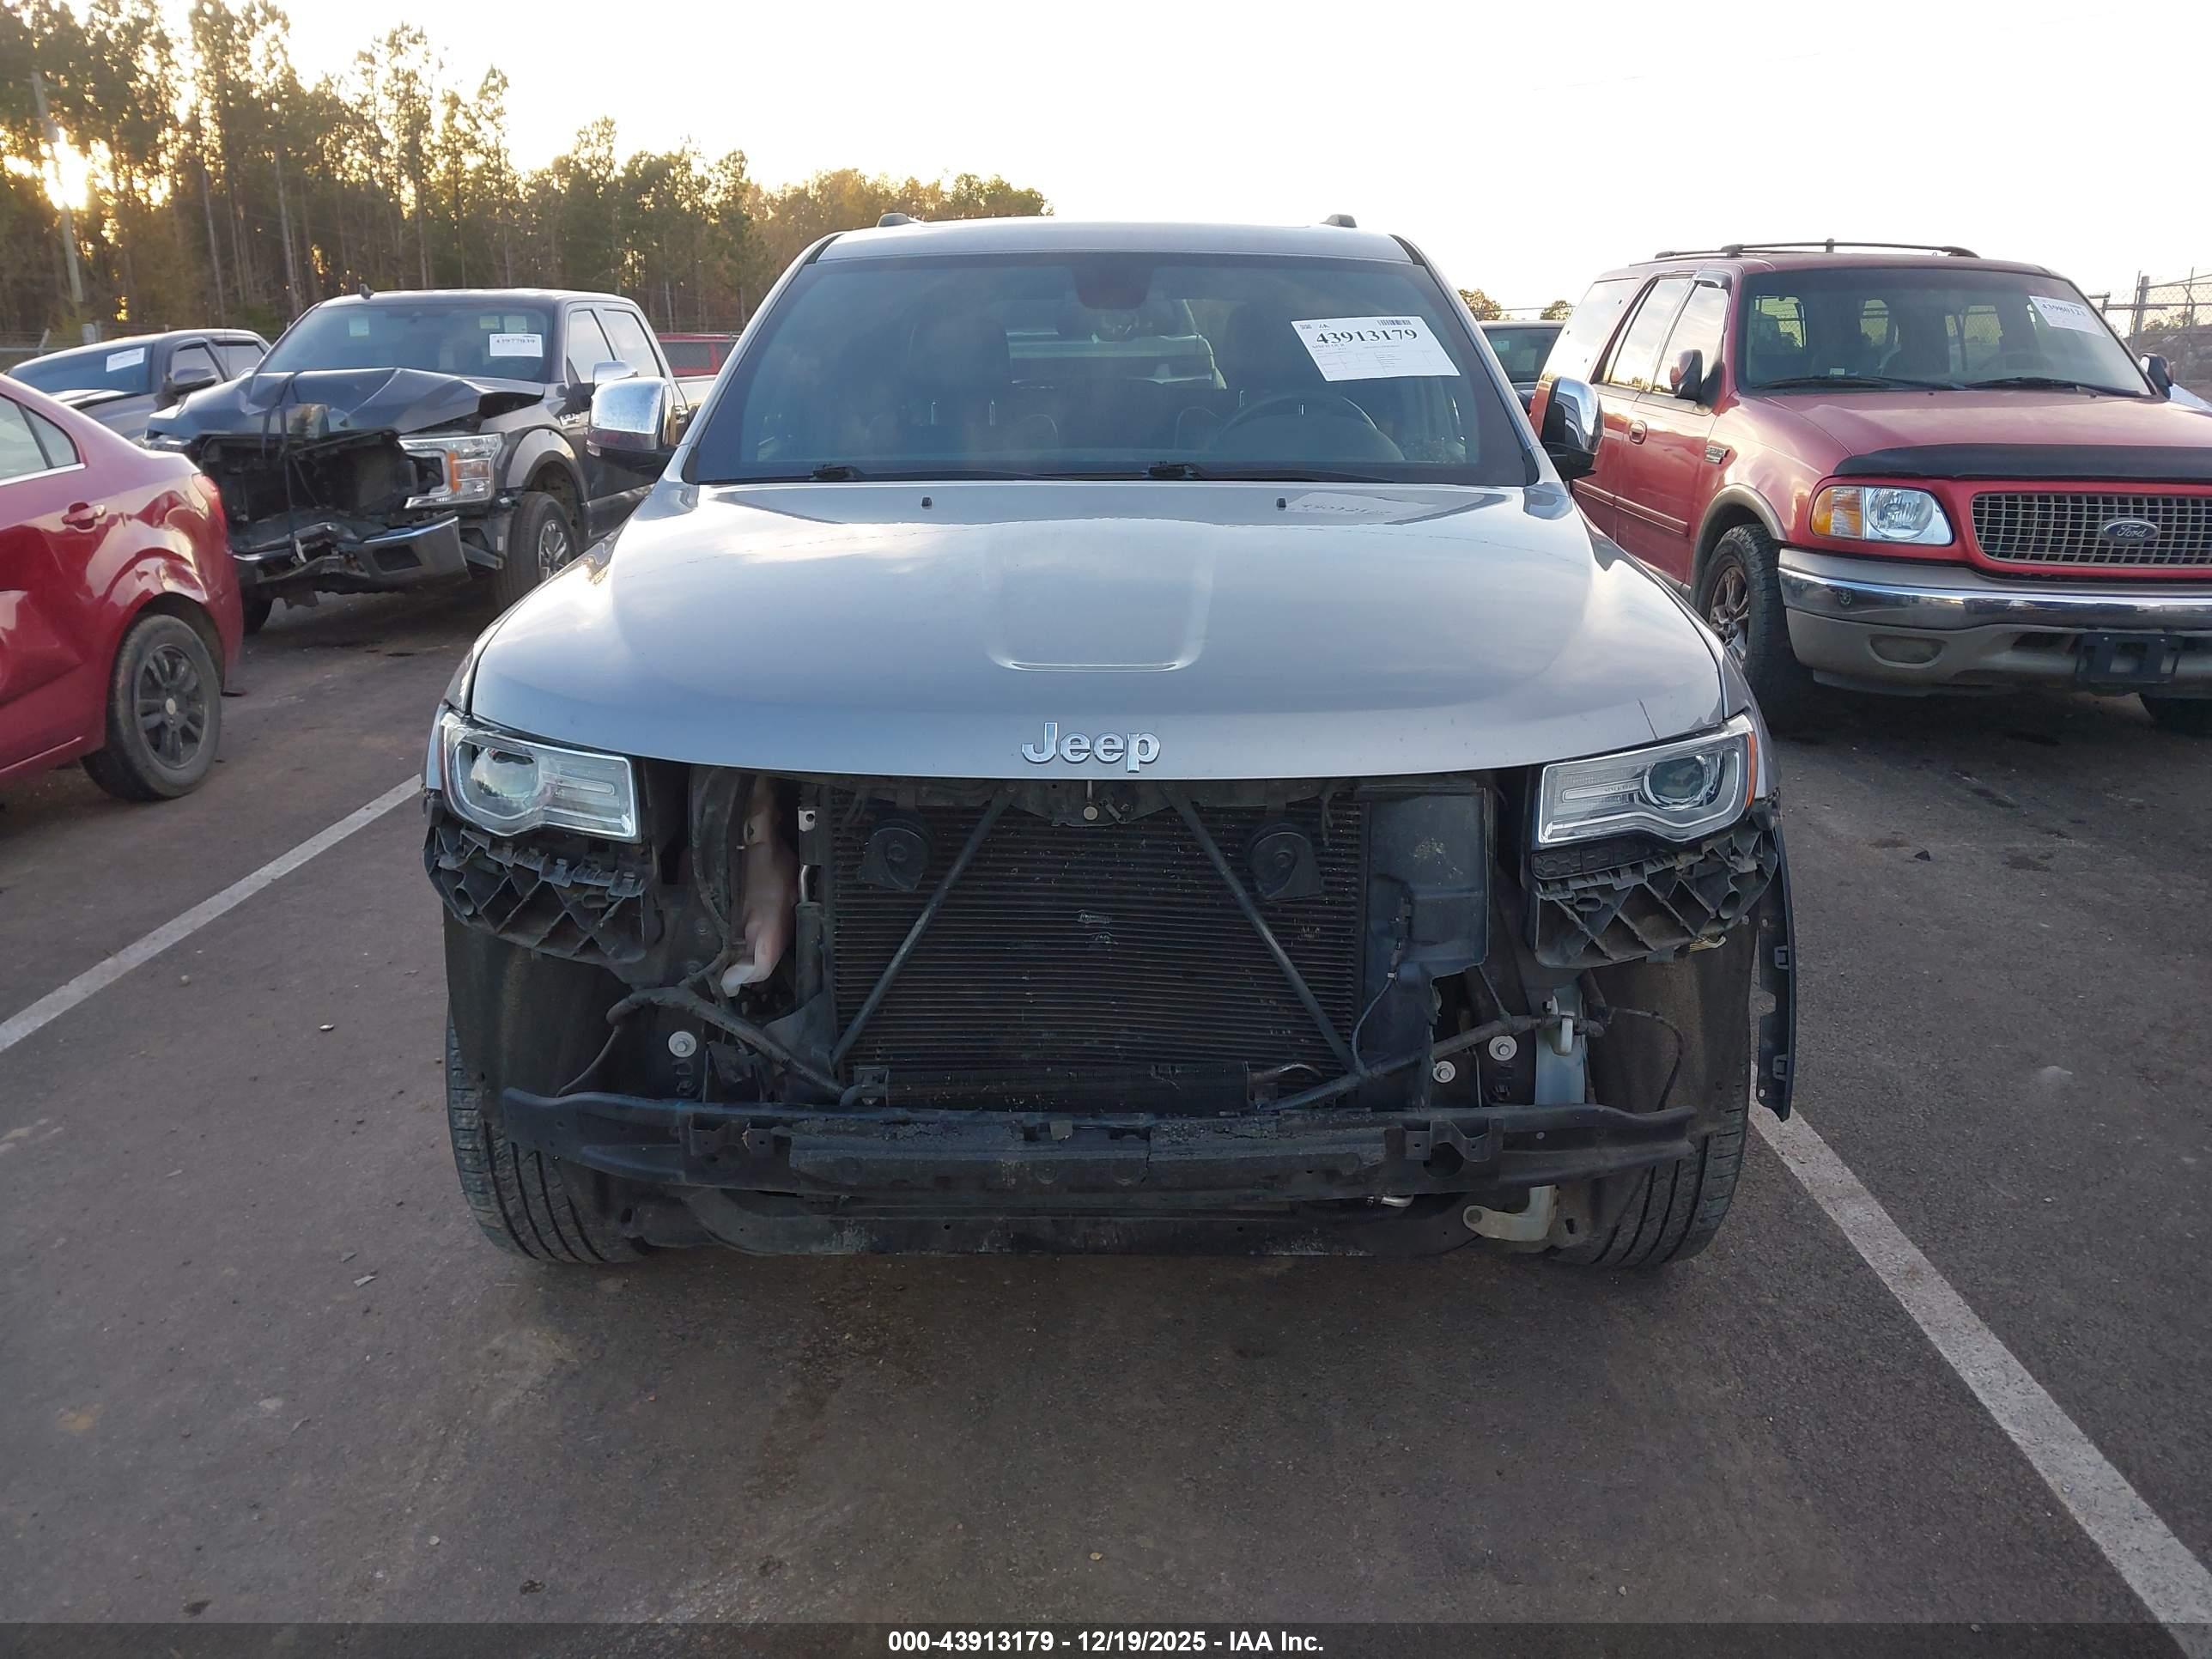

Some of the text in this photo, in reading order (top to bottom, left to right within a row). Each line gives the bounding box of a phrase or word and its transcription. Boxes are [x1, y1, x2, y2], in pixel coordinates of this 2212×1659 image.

[1316, 328, 1418, 345] 43913179
[2116, 524, 2148, 538] Ford
[1021, 720, 1161, 774] Jeep
